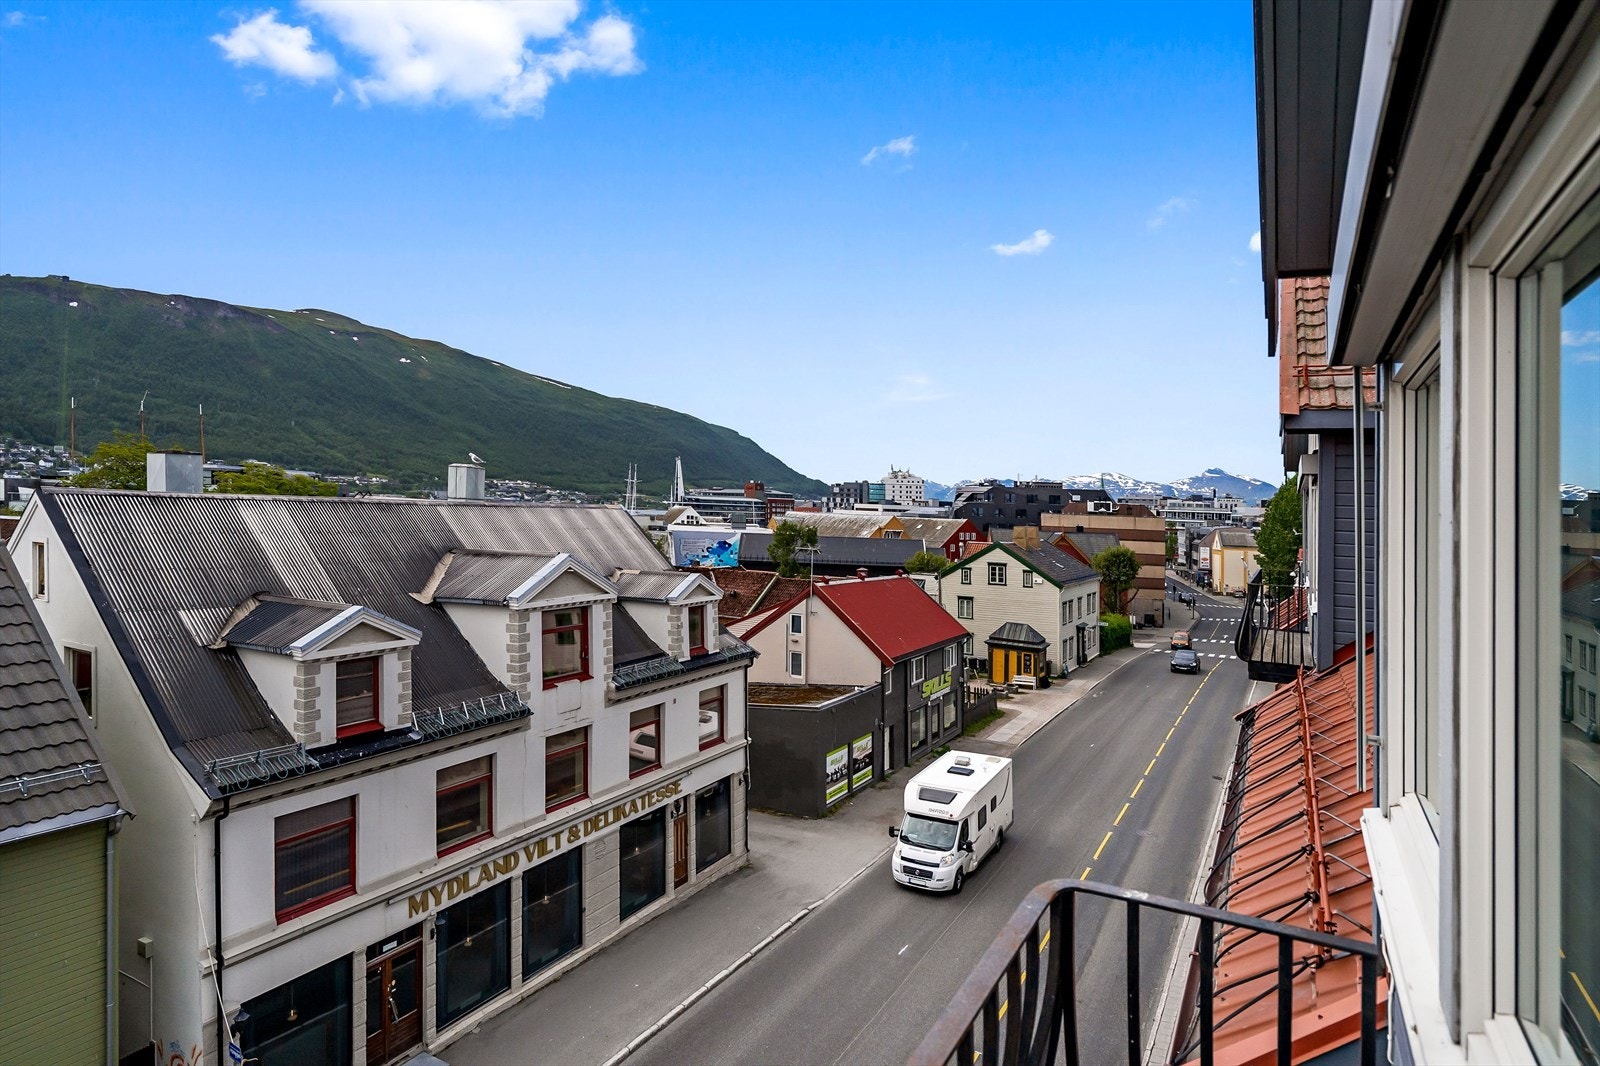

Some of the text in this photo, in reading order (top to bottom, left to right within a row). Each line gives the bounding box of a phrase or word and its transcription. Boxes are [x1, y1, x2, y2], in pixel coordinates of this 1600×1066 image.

[922, 671, 952, 698] SKILLS
[408, 779, 683, 919] MYDLAND VILT & DELIKATESSE
